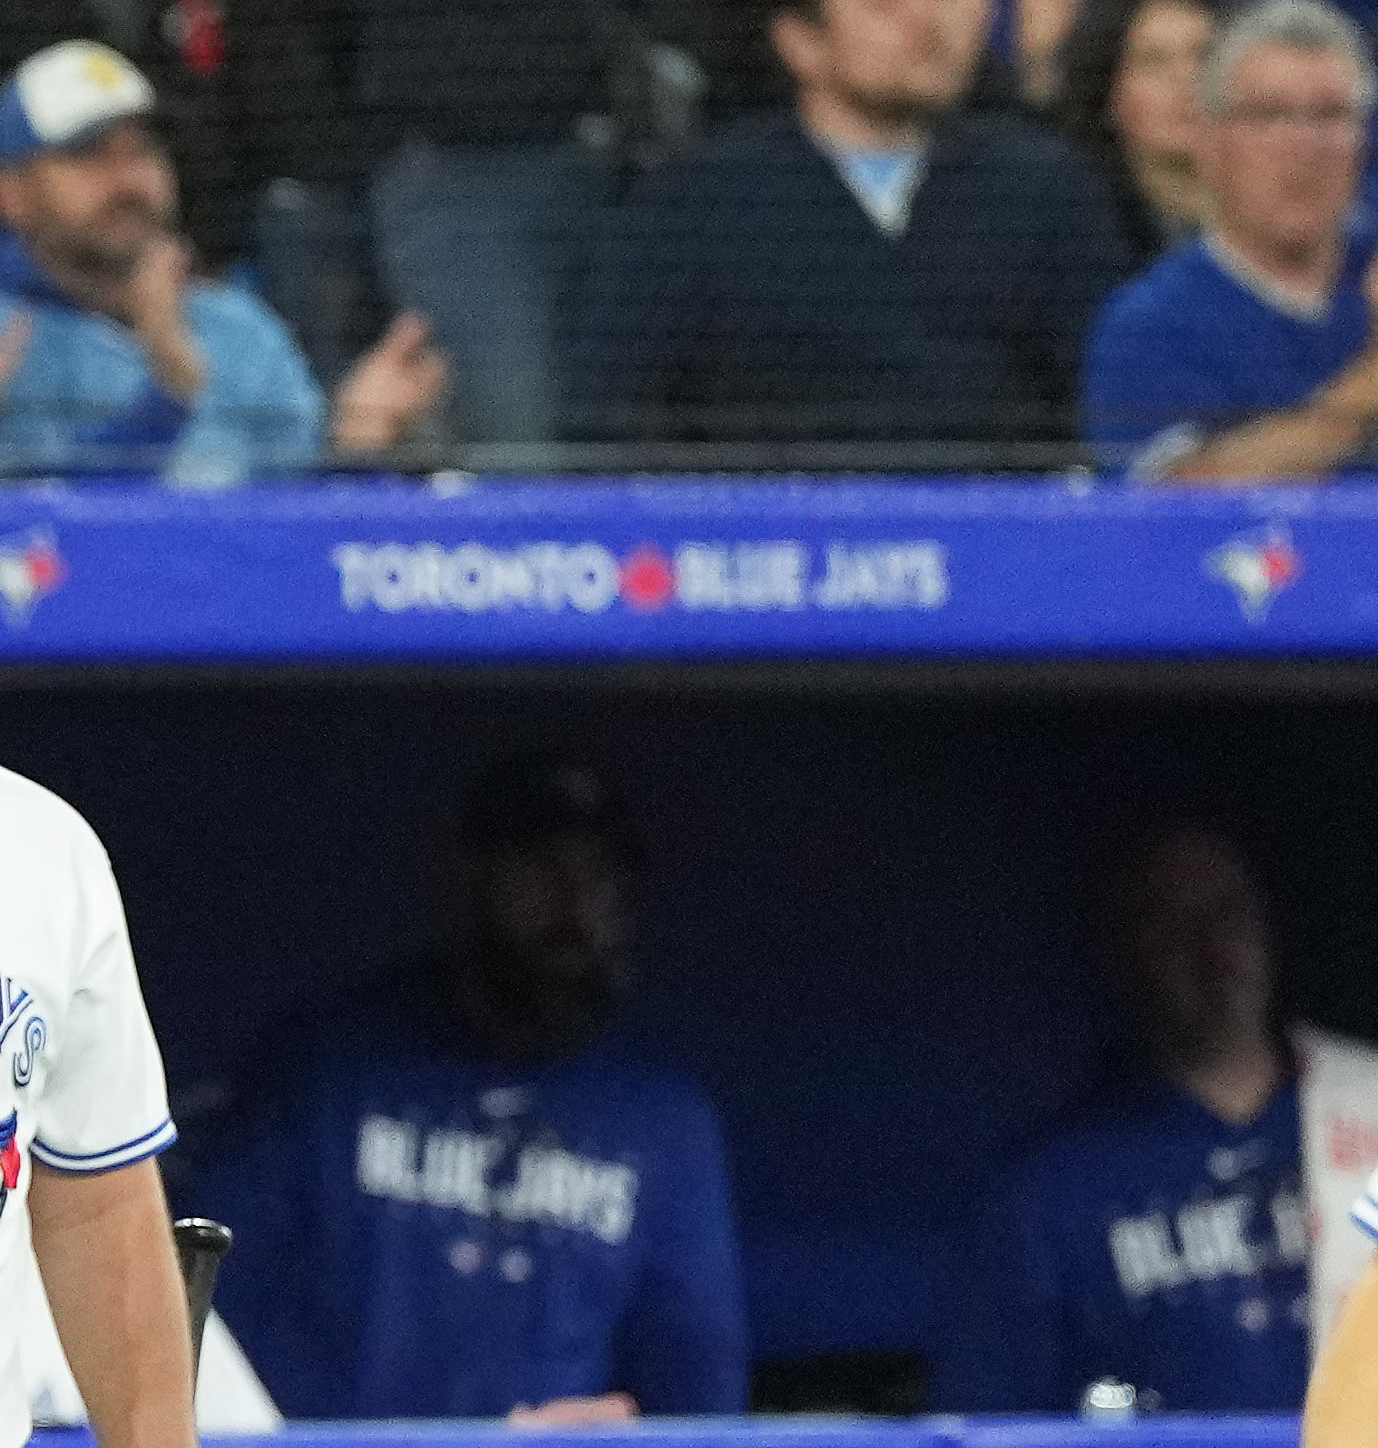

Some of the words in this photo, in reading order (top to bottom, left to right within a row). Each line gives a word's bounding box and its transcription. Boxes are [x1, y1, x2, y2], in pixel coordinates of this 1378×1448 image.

[333, 541, 620, 614] TORONTO
[673, 541, 811, 613] BLUE
[815, 541, 948, 613] JAYS
